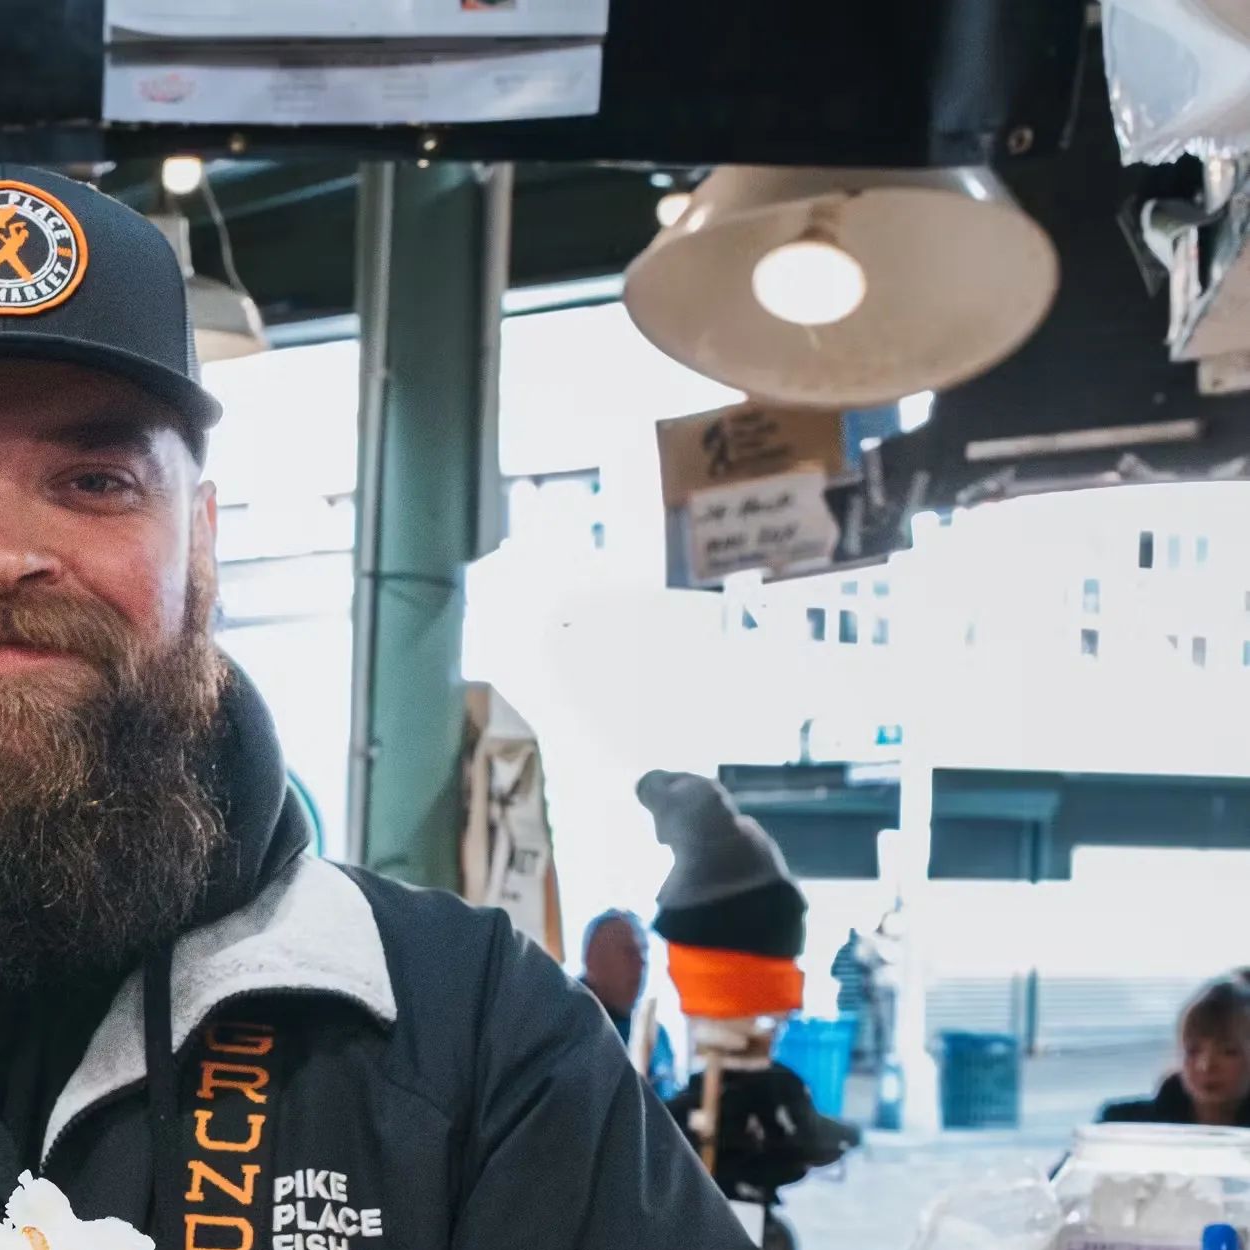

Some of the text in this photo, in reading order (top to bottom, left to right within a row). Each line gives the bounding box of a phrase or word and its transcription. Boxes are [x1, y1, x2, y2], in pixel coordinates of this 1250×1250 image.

[7, 193, 70, 241] PLACE
[273, 1168, 348, 1203] PIKE
[272, 1201, 383, 1237] PLACE
